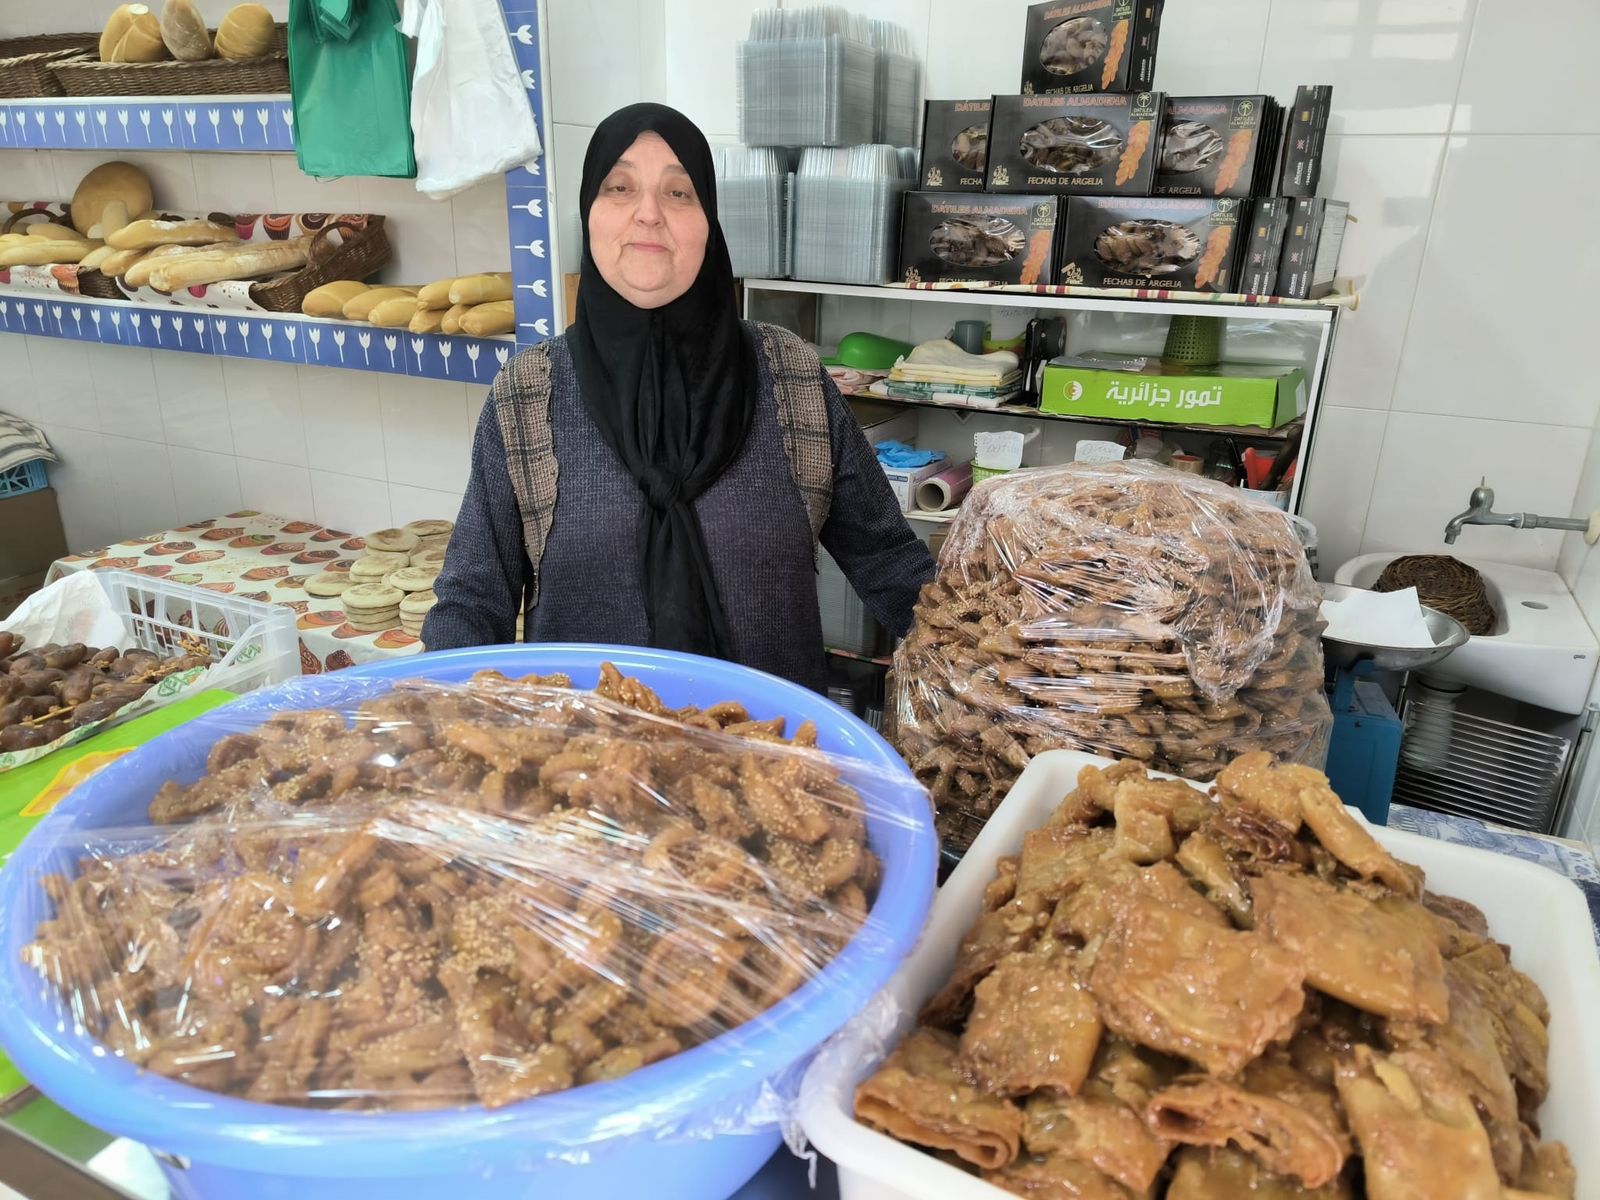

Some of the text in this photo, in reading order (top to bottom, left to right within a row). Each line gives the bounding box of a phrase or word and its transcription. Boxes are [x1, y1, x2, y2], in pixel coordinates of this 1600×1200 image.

[954, 99, 991, 111] DÁTILE
[959, 177, 983, 185] FECHA
[1027, 176, 1104, 186] FECHAS DE ARGELIA
[1167, 186, 1202, 195] ARGELIA
[1102, 277, 1182, 288] FECHAS DE ARGELIA
[1105, 380, 1222, 409] تمور جزائرية
